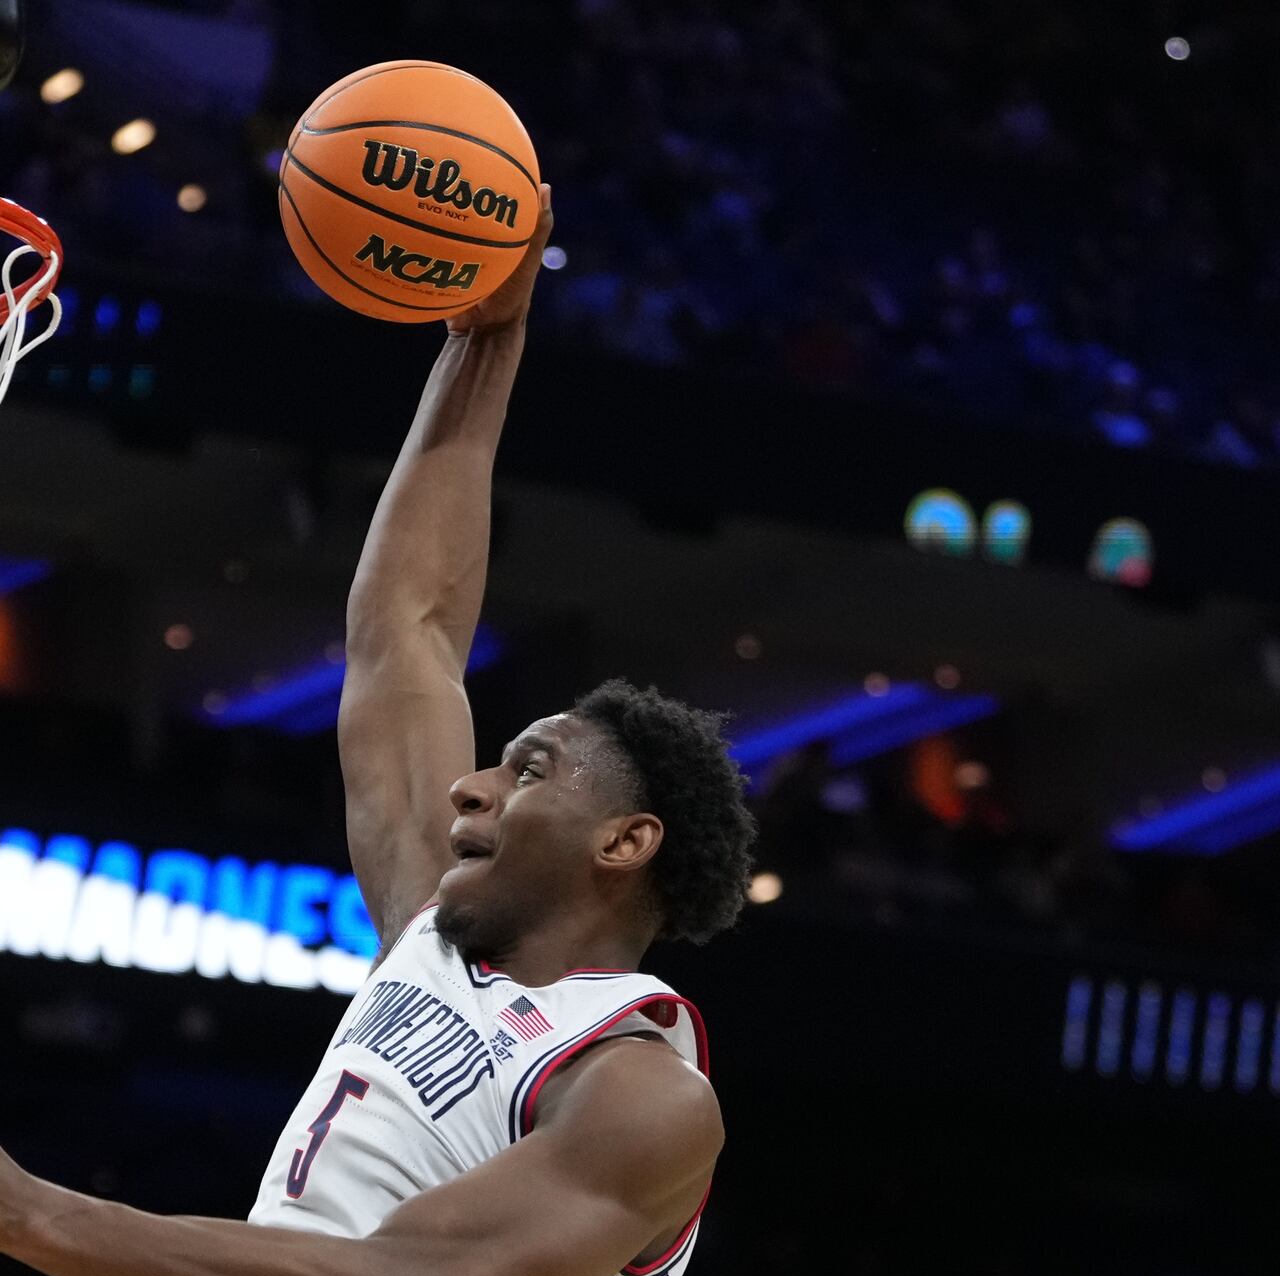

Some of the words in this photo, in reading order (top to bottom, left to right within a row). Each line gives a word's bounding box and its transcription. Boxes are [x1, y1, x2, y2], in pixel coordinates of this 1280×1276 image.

[362, 139, 518, 229] Wilson
[417, 202, 442, 215] EVO
[445, 210, 469, 222] NXT
[354, 234, 481, 290] NCAA
[333, 980, 495, 1122] CONNECTICUT
[495, 1030, 517, 1047] BIG
[286, 1069, 370, 1200] 5
